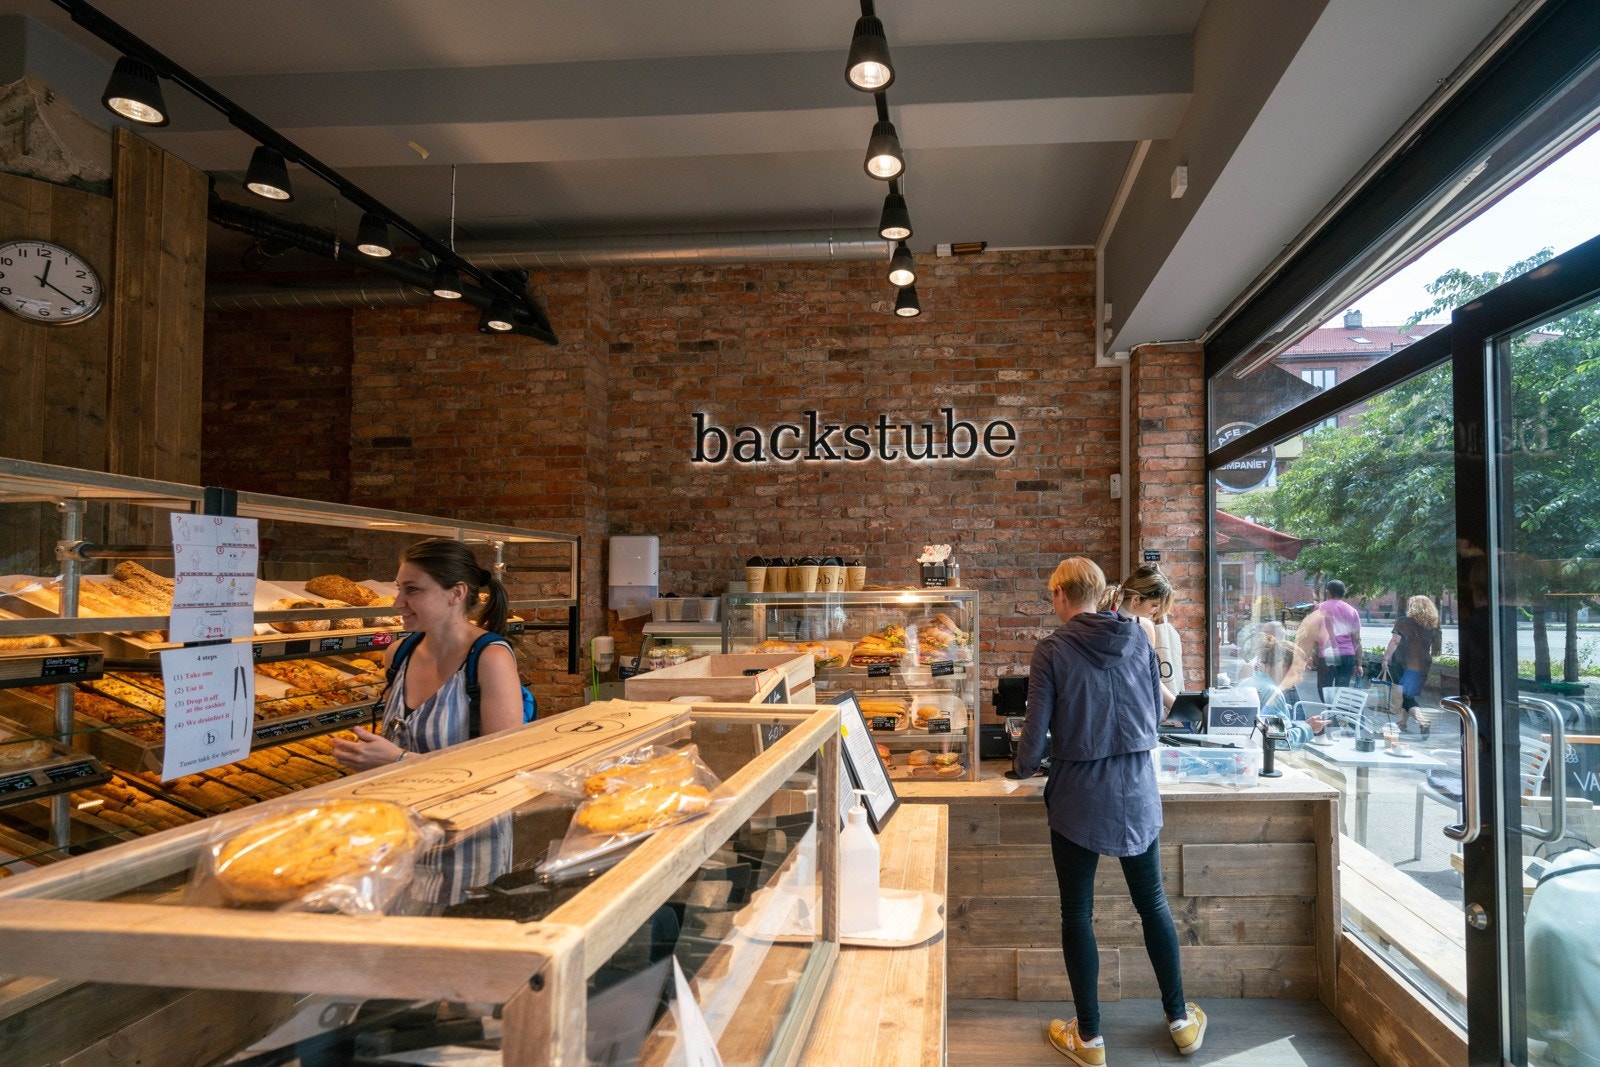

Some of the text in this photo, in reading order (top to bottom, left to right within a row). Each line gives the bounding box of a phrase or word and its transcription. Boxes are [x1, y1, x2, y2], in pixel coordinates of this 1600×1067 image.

[18, 249, 27, 258] 11
[37, 248, 52, 258] 12
[1, 257, 13, 266] 10
[65, 257, 68, 265] 1
[75, 270, 86, 279] 2
[0, 286, 12, 295] 8
[82, 285, 93, 294] 3
[16, 299, 27, 308] 7
[38, 308, 50, 316] 6
[61, 307, 72, 315] 5
[691, 407, 1017, 463] backstube
[1217, 428, 1242, 447] AFE
[1217, 459, 1268, 470] MPANIET
[202, 654, 218, 662] steps
[185, 671, 201, 679] Take
[204, 702, 225, 710] cashier
[197, 713, 225, 724] desinfect
[207, 732, 216, 745] b
[179, 759, 197, 768] Tusen
[198, 755, 210, 763] takk
[211, 752, 221, 760] for
[1573, 771, 1600, 792] VA
